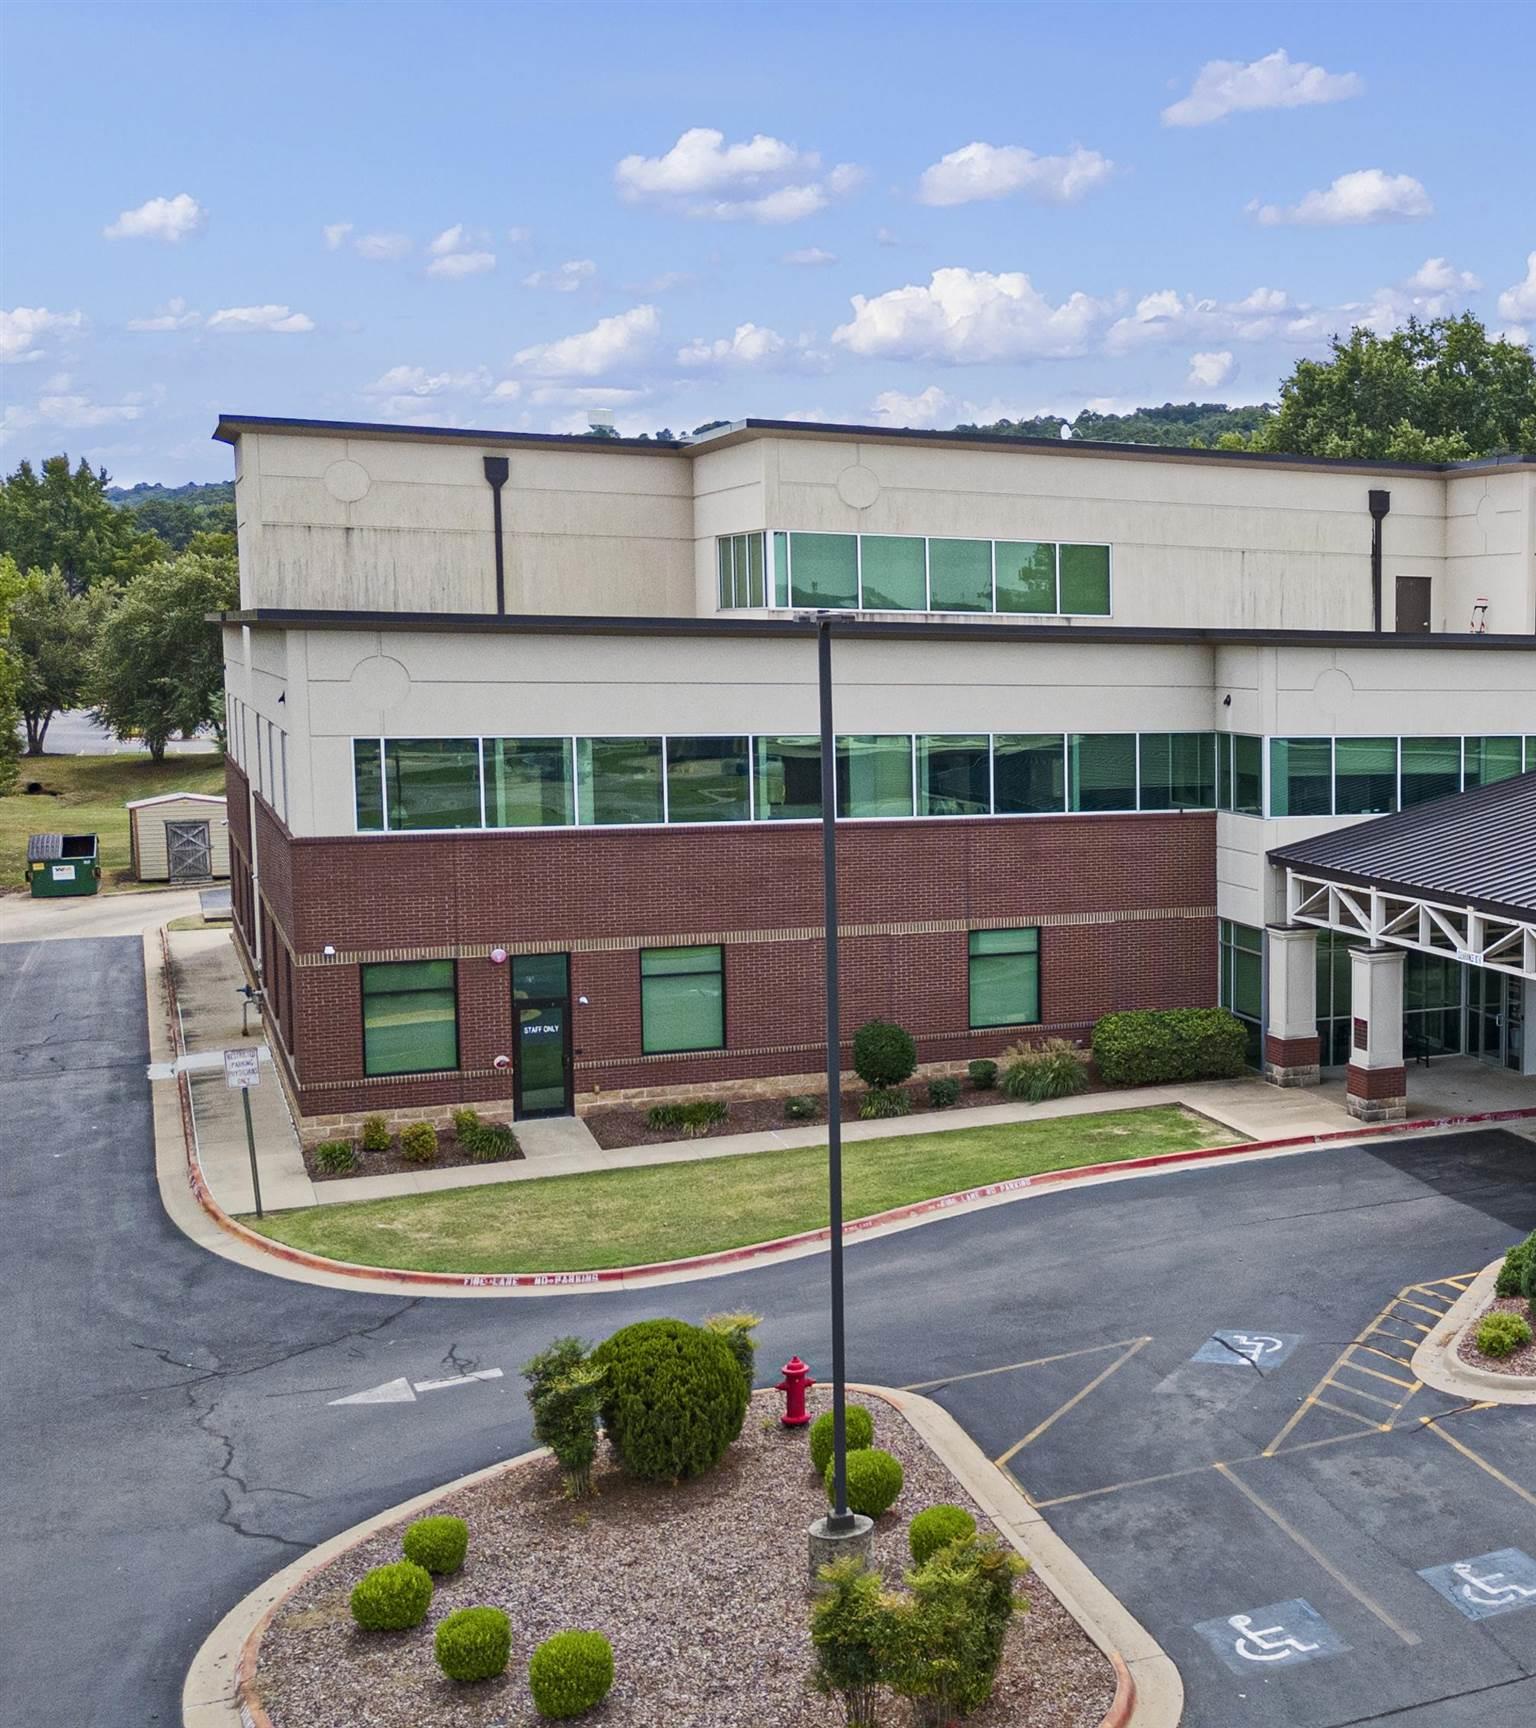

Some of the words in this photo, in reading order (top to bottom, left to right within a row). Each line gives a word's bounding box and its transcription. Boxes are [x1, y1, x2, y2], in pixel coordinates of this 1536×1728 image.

[523, 1025, 542, 1035] STAFF
[543, 1025, 560, 1034] ONLY
[463, 1277, 486, 1287] FIRE
[492, 1277, 519, 1287] LANE
[554, 1273, 599, 1285] PARKING
